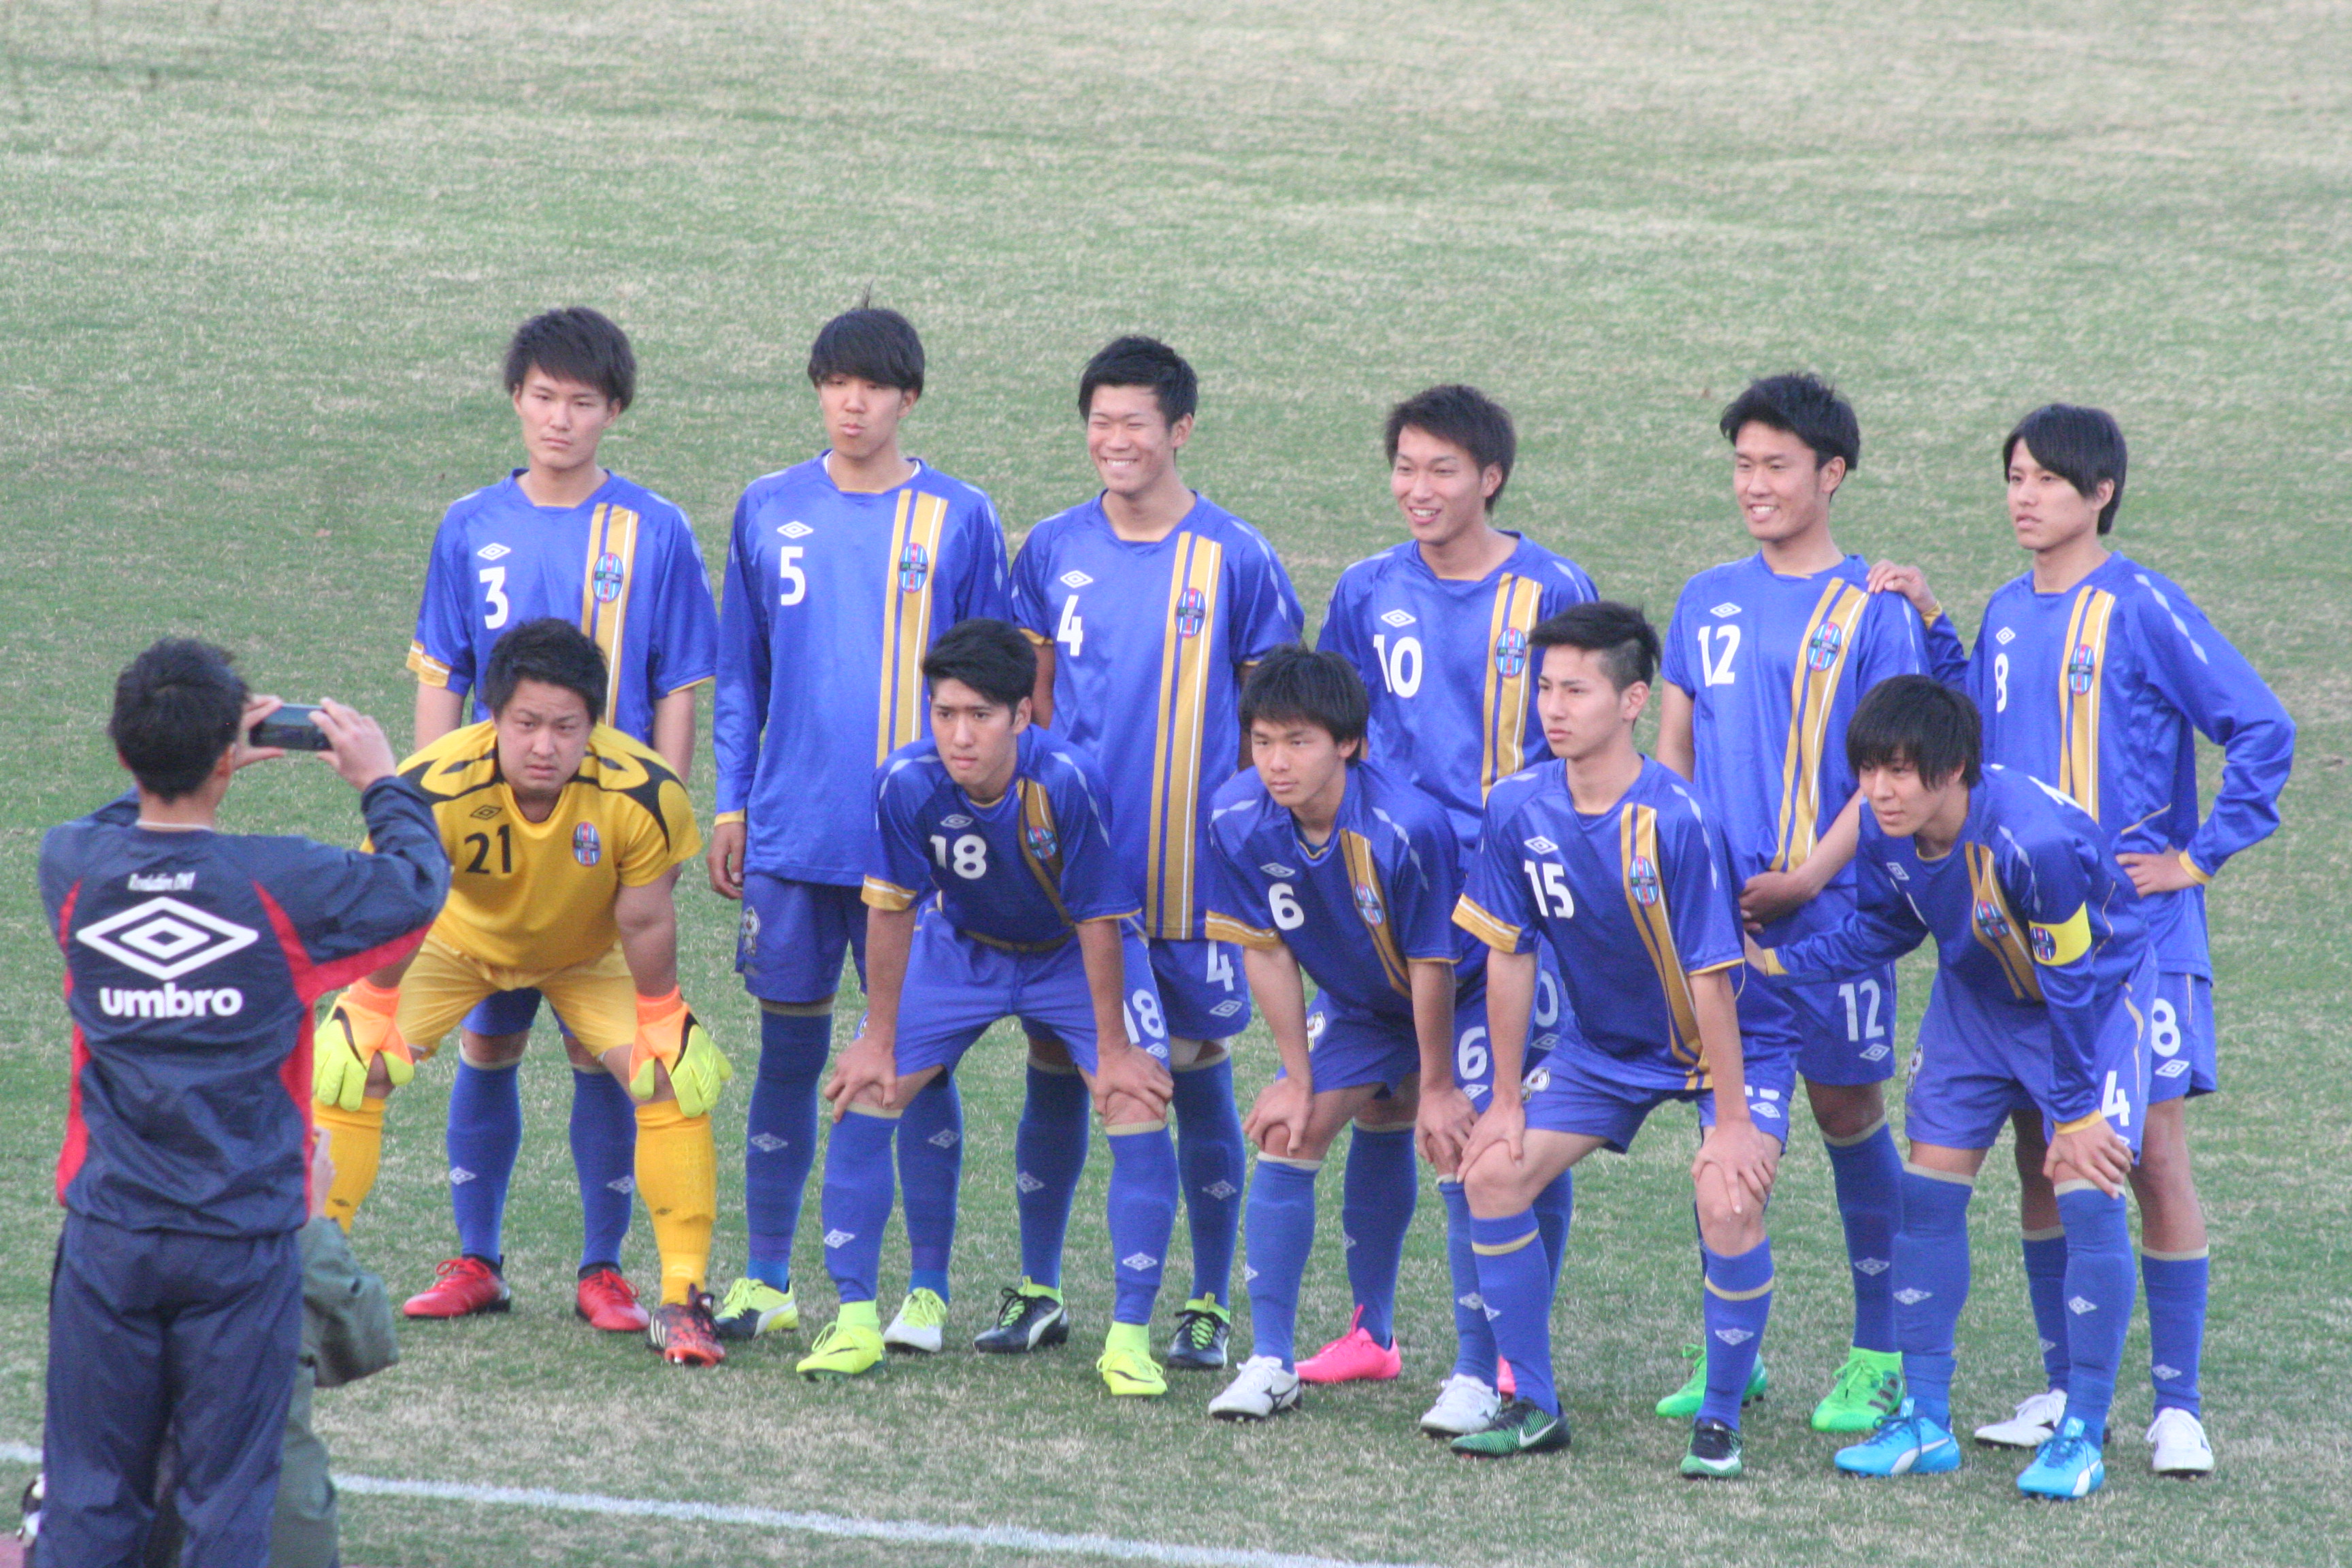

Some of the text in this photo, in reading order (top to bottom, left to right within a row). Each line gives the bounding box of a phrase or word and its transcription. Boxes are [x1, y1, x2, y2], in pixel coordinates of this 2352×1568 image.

[478, 566, 509, 630] 3
[780, 545, 806, 606] 5
[1056, 594, 1084, 657] 4
[1373, 634, 1423, 698] 10
[1697, 624, 1742, 687] 12
[1994, 653, 2009, 713] 8
[464, 823, 512, 875] 21
[930, 834, 987, 879] 18
[1268, 883, 1305, 931] 6
[1524, 860, 1574, 919] 15
[1206, 941, 1234, 992] 4
[99, 983, 243, 1019] umbro
[1123, 989, 1165, 1045] 18
[1535, 970, 1558, 1028] 0
[1838, 979, 1885, 1042] 12
[2151, 998, 2181, 1058] 8
[1458, 1026, 1488, 1080] 6
[2101, 1071, 2131, 1127] 4
